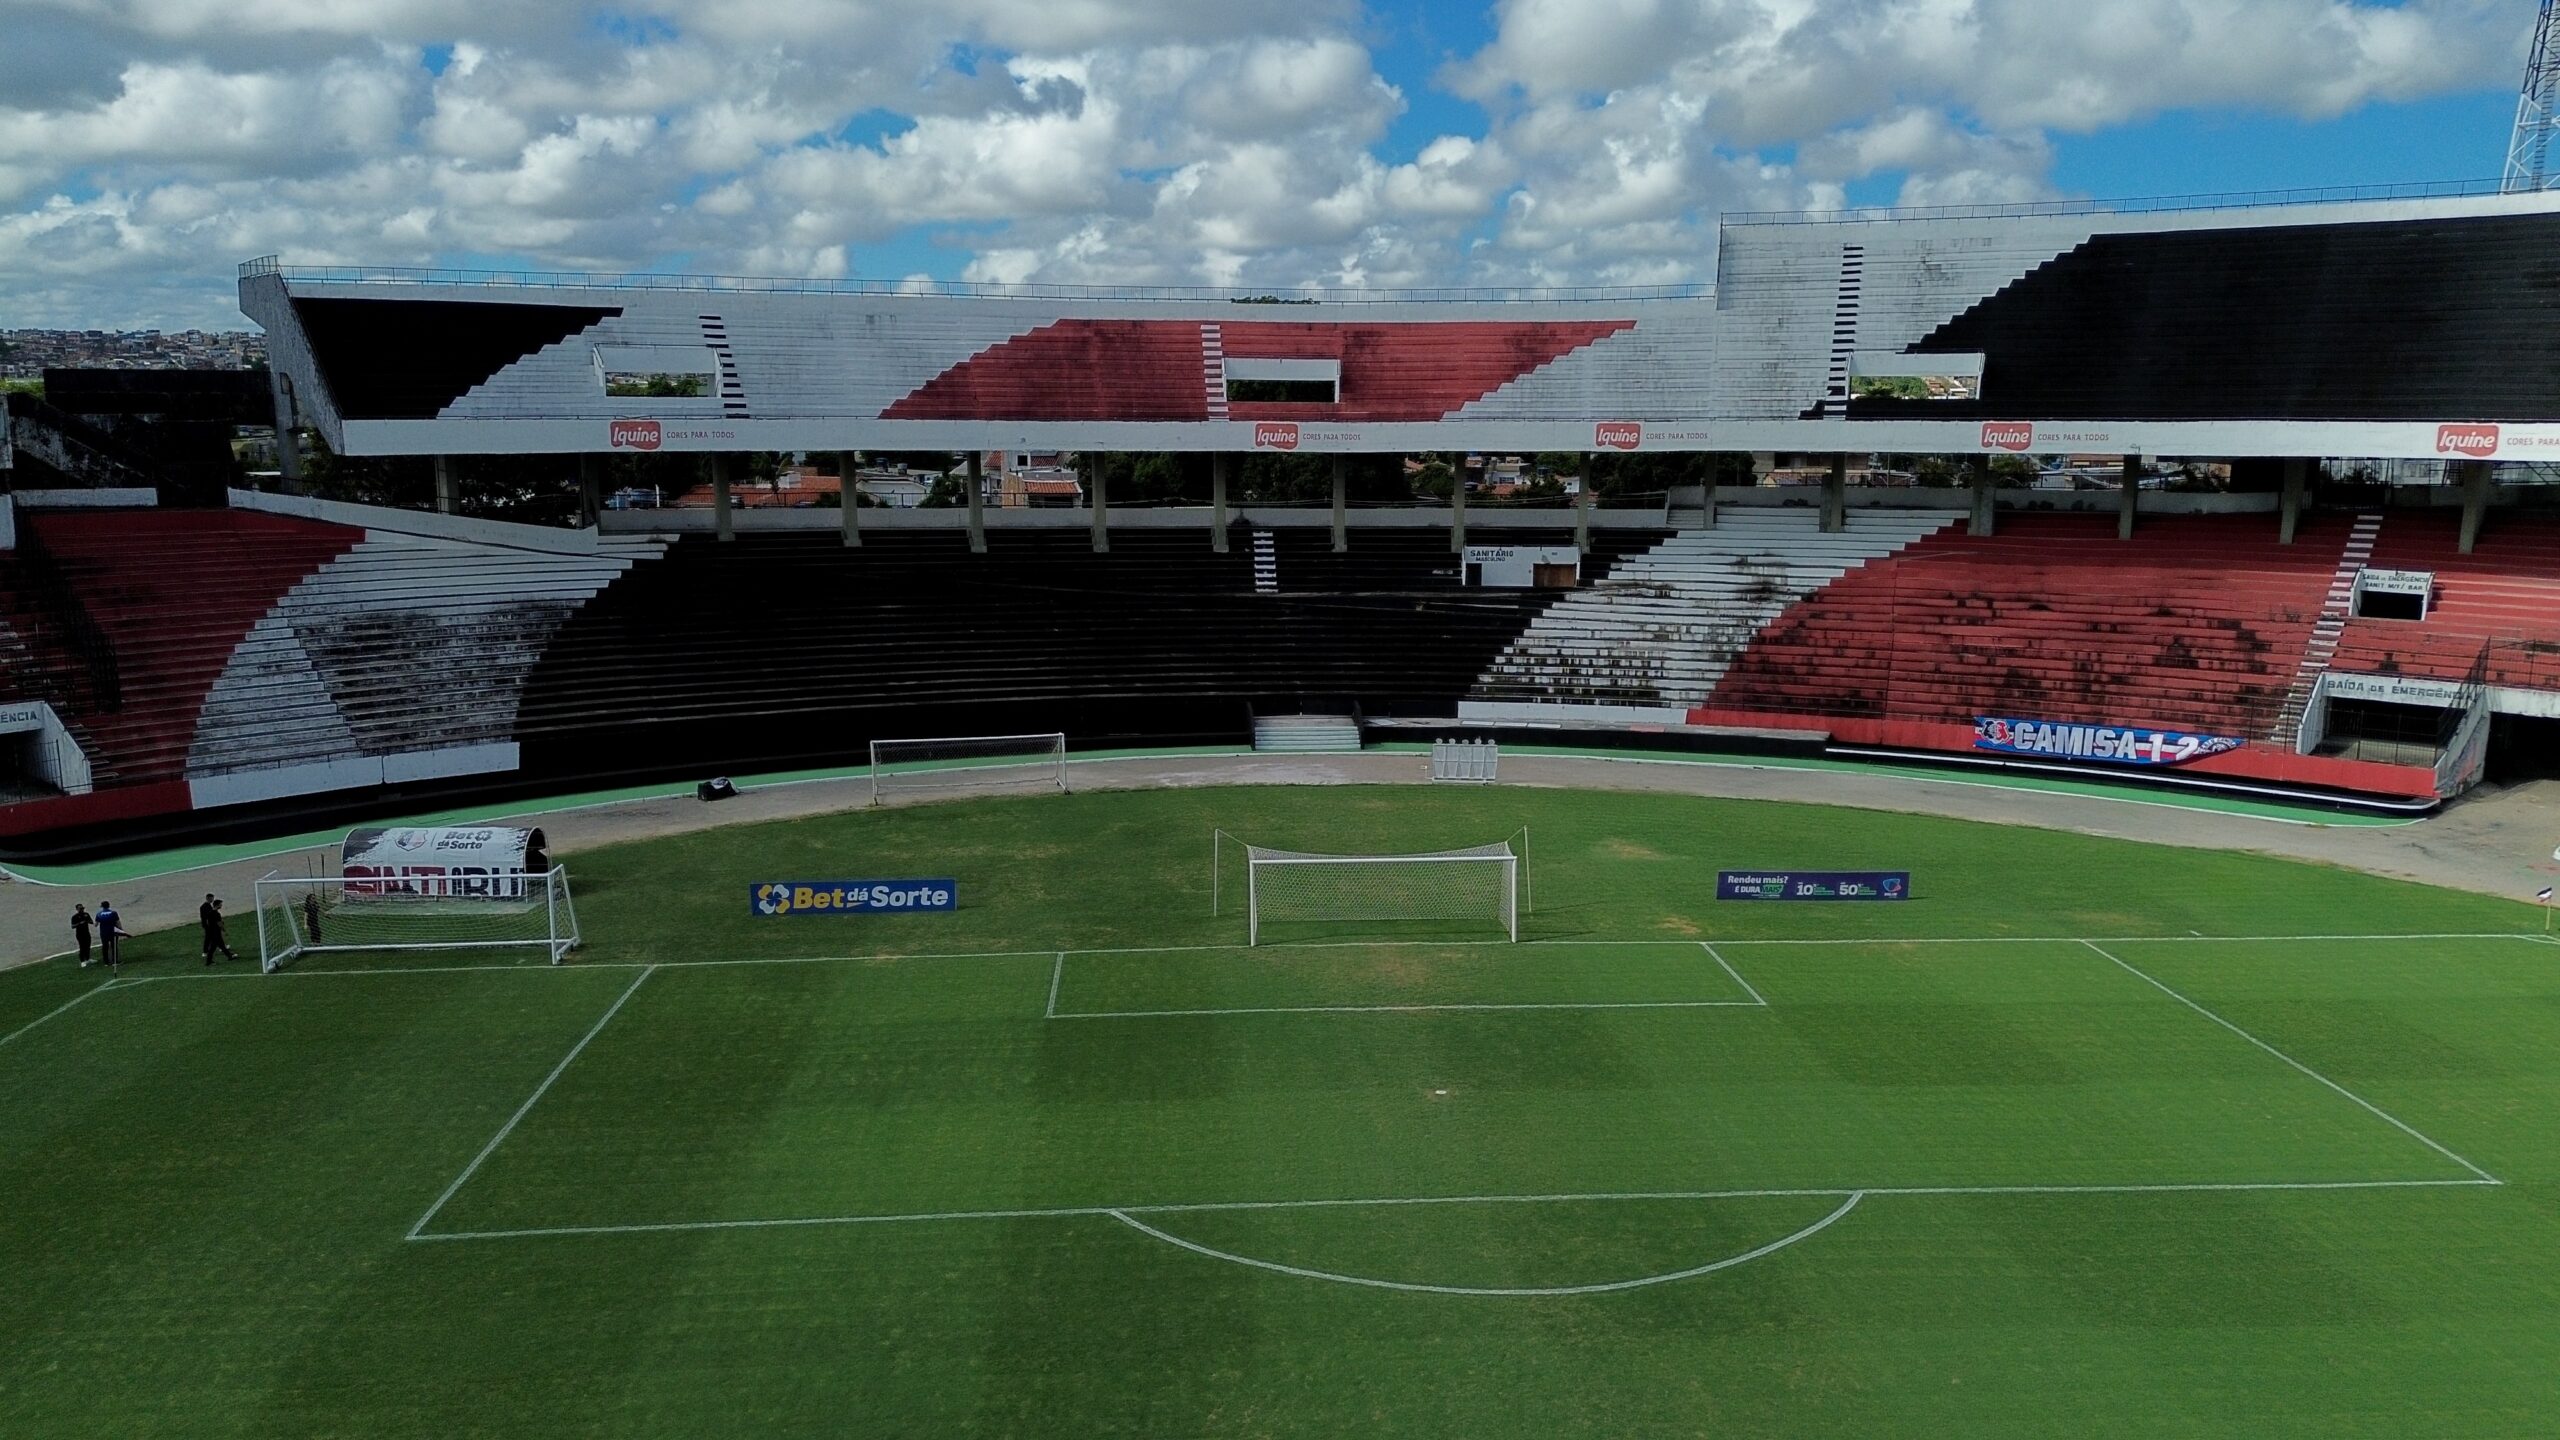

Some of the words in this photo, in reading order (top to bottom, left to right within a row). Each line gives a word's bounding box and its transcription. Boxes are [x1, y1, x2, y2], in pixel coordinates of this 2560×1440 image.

[613, 427, 659, 446] Iquine
[666, 431, 688, 439] CORES
[691, 431, 709, 439] PARA
[712, 431, 735, 439] TODOS
[1257, 428, 1296, 445] Iquine
[1598, 428, 1638, 445] Iquine
[1983, 428, 2030, 446] Iquine
[2037, 433, 2060, 441] CORES
[2063, 433, 2081, 441] PARA
[2085, 433, 2109, 441] TODOS
[2439, 430, 2496, 452] Iquine
[2507, 437, 2534, 446] CORES
[2327, 679, 2364, 692] SAÍDA
[2370, 685, 2385, 693] DE
[2013, 722, 2137, 759] CAMISA
[449, 840, 483, 849] Sorte
[1727, 875, 1761, 884] Rendeu
[1762, 875, 1789, 884] mais?
[793, 887, 845, 909] Bet
[847, 887, 869, 902] dá
[870, 885, 949, 908] Sorte
